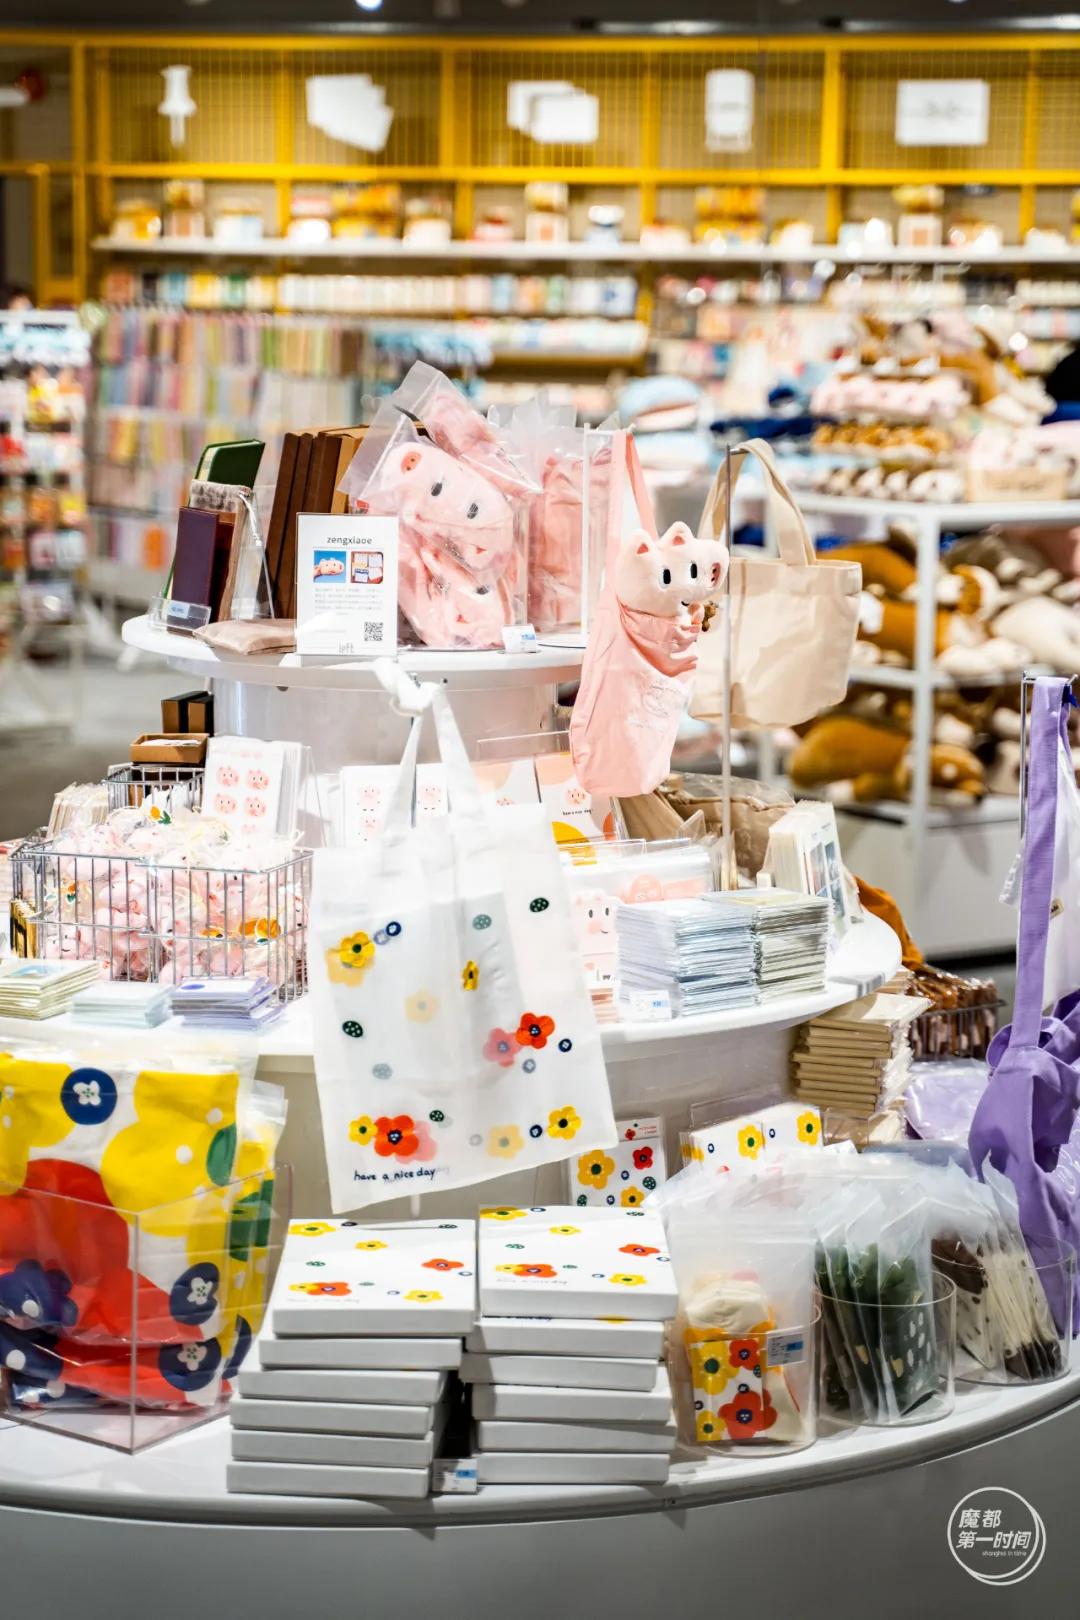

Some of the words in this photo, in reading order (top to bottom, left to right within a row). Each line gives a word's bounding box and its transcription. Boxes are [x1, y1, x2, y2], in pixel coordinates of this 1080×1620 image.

[326, 535, 373, 546] zengxiaoe
[353, 1169, 377, 1181] have
[394, 1170, 414, 1179] nice
[416, 1167, 436, 1181] day
